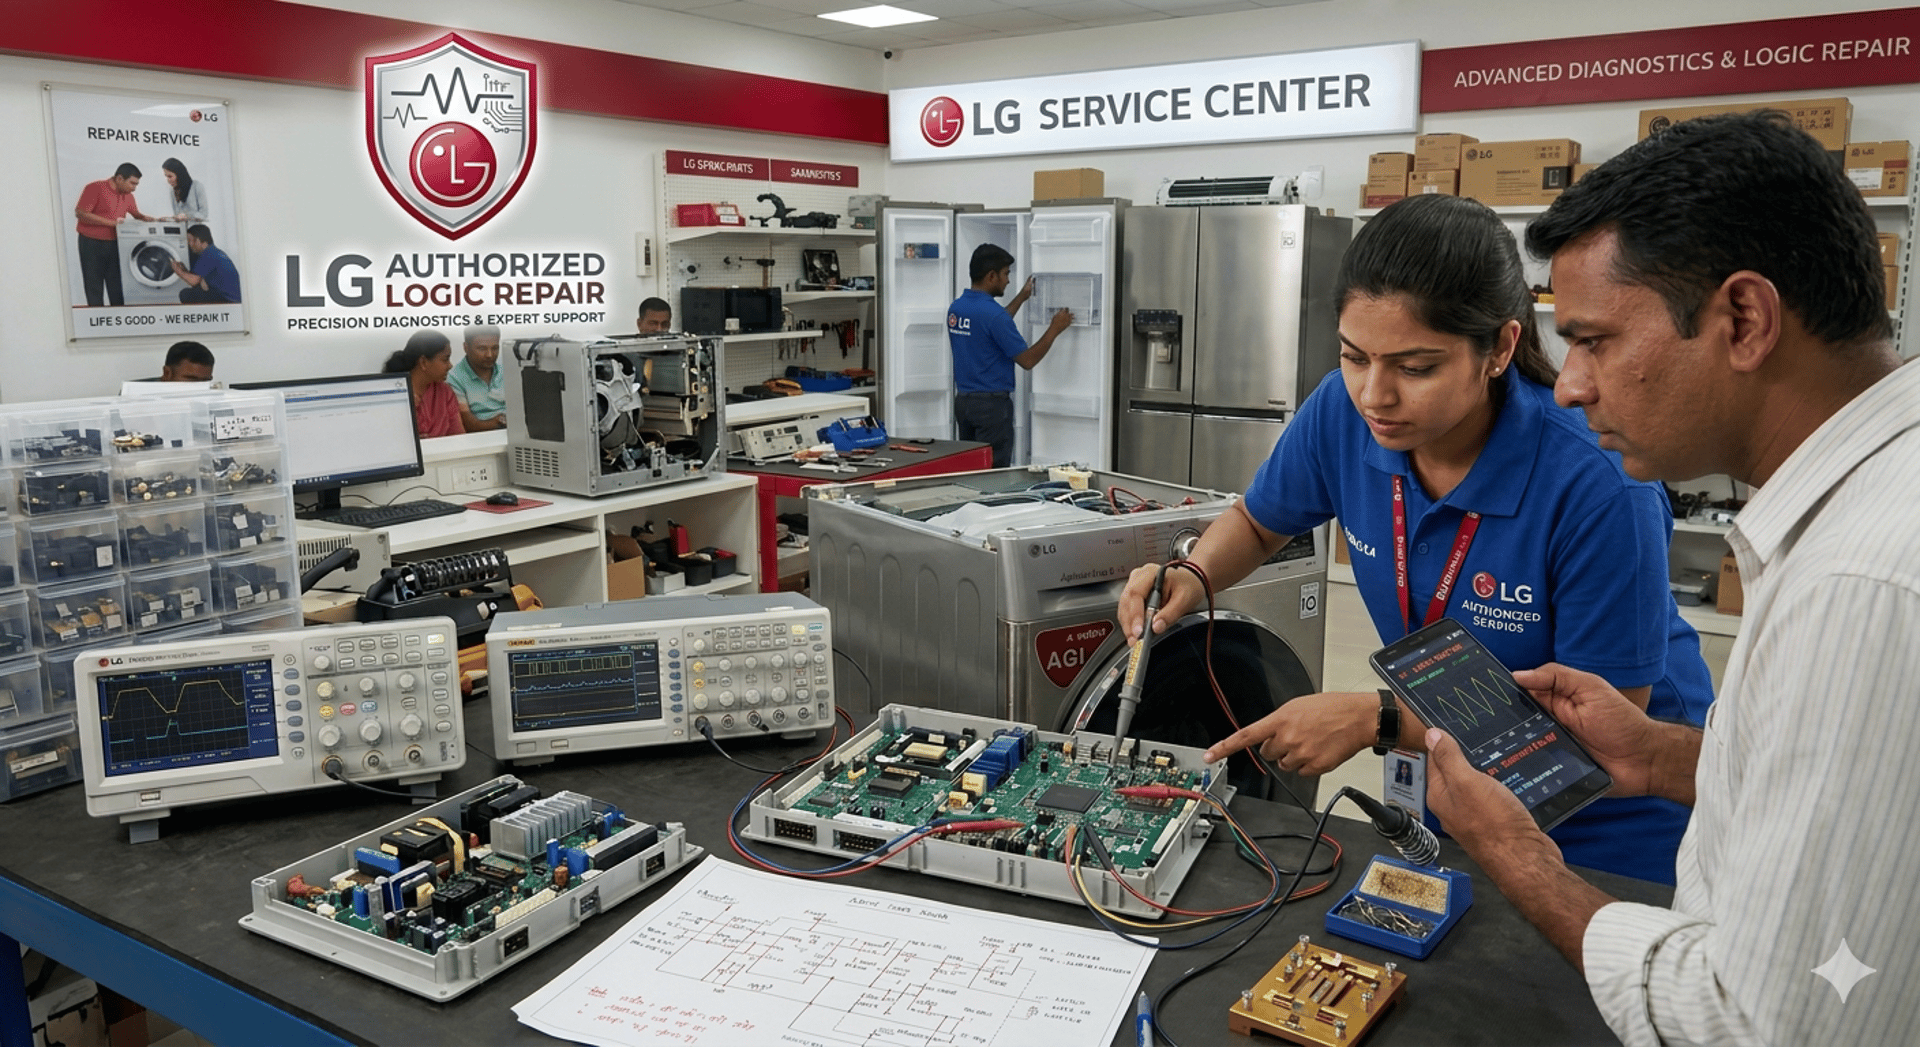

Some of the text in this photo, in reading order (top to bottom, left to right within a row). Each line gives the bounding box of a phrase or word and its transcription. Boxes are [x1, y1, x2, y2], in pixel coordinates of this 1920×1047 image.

[1453, 36, 1911, 88] ADVANCED DIAGNOSTICS & LOGIC REPAIR
[972, 100, 1021, 136] LG
[1039, 87, 1192, 130] SERVICE
[1204, 73, 1371, 118] CENTER
[204, 113, 218, 123] LG
[87, 126, 200, 147] REPAIR SERVICE
[683, 158, 696, 170] LG
[89, 316, 113, 327] LIFE
[165, 314, 181, 324] WE
[220, 312, 230, 323] IT
[1042, 544, 1057, 555] LG
[1500, 582, 1534, 604] LG
